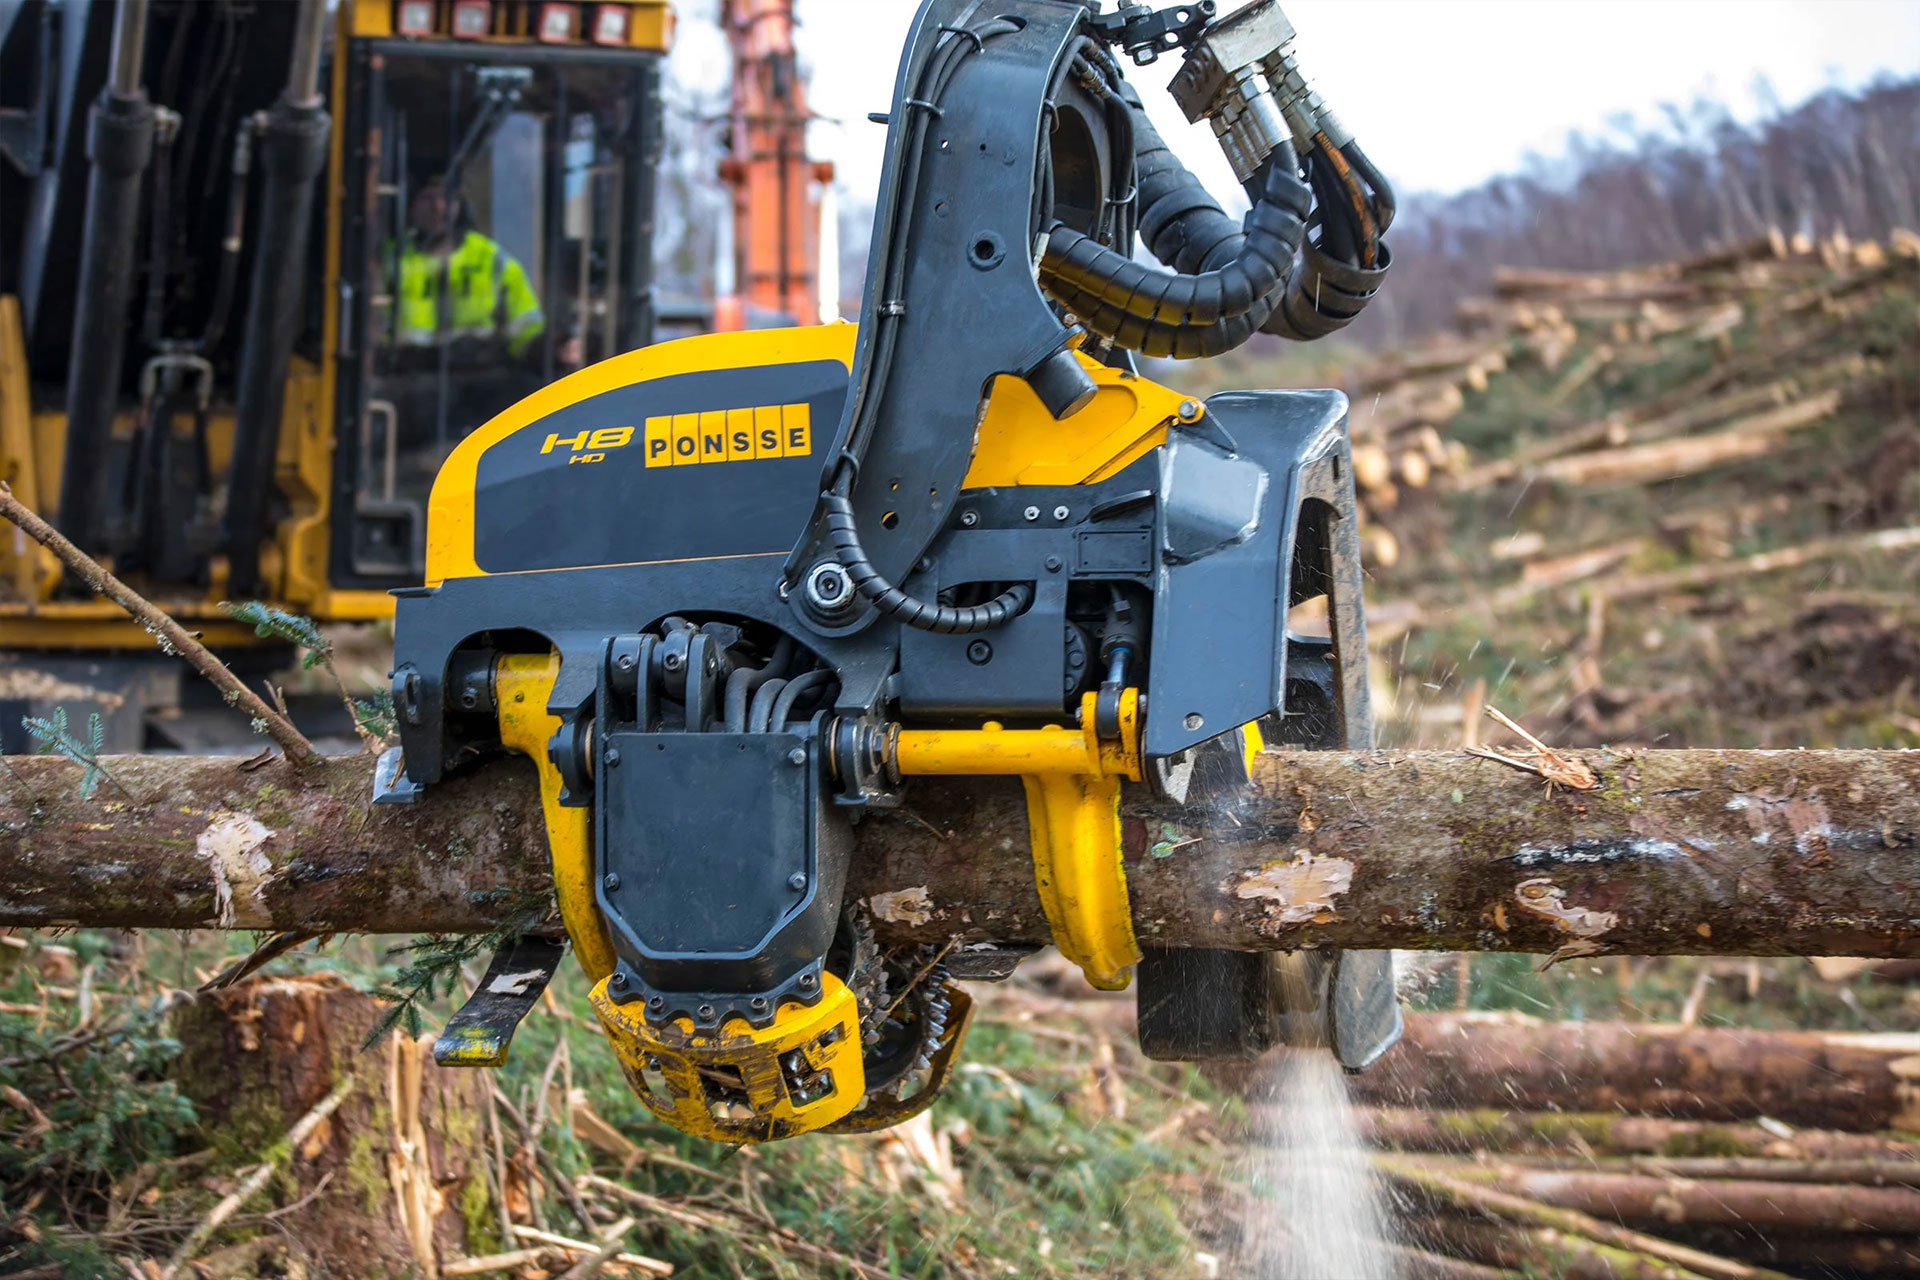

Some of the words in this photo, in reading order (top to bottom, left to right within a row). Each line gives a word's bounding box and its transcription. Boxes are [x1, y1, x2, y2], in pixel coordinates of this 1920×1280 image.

[540, 426, 635, 454] H8
[650, 427, 805, 458] PONSSE
[569, 453, 606, 465] HD
